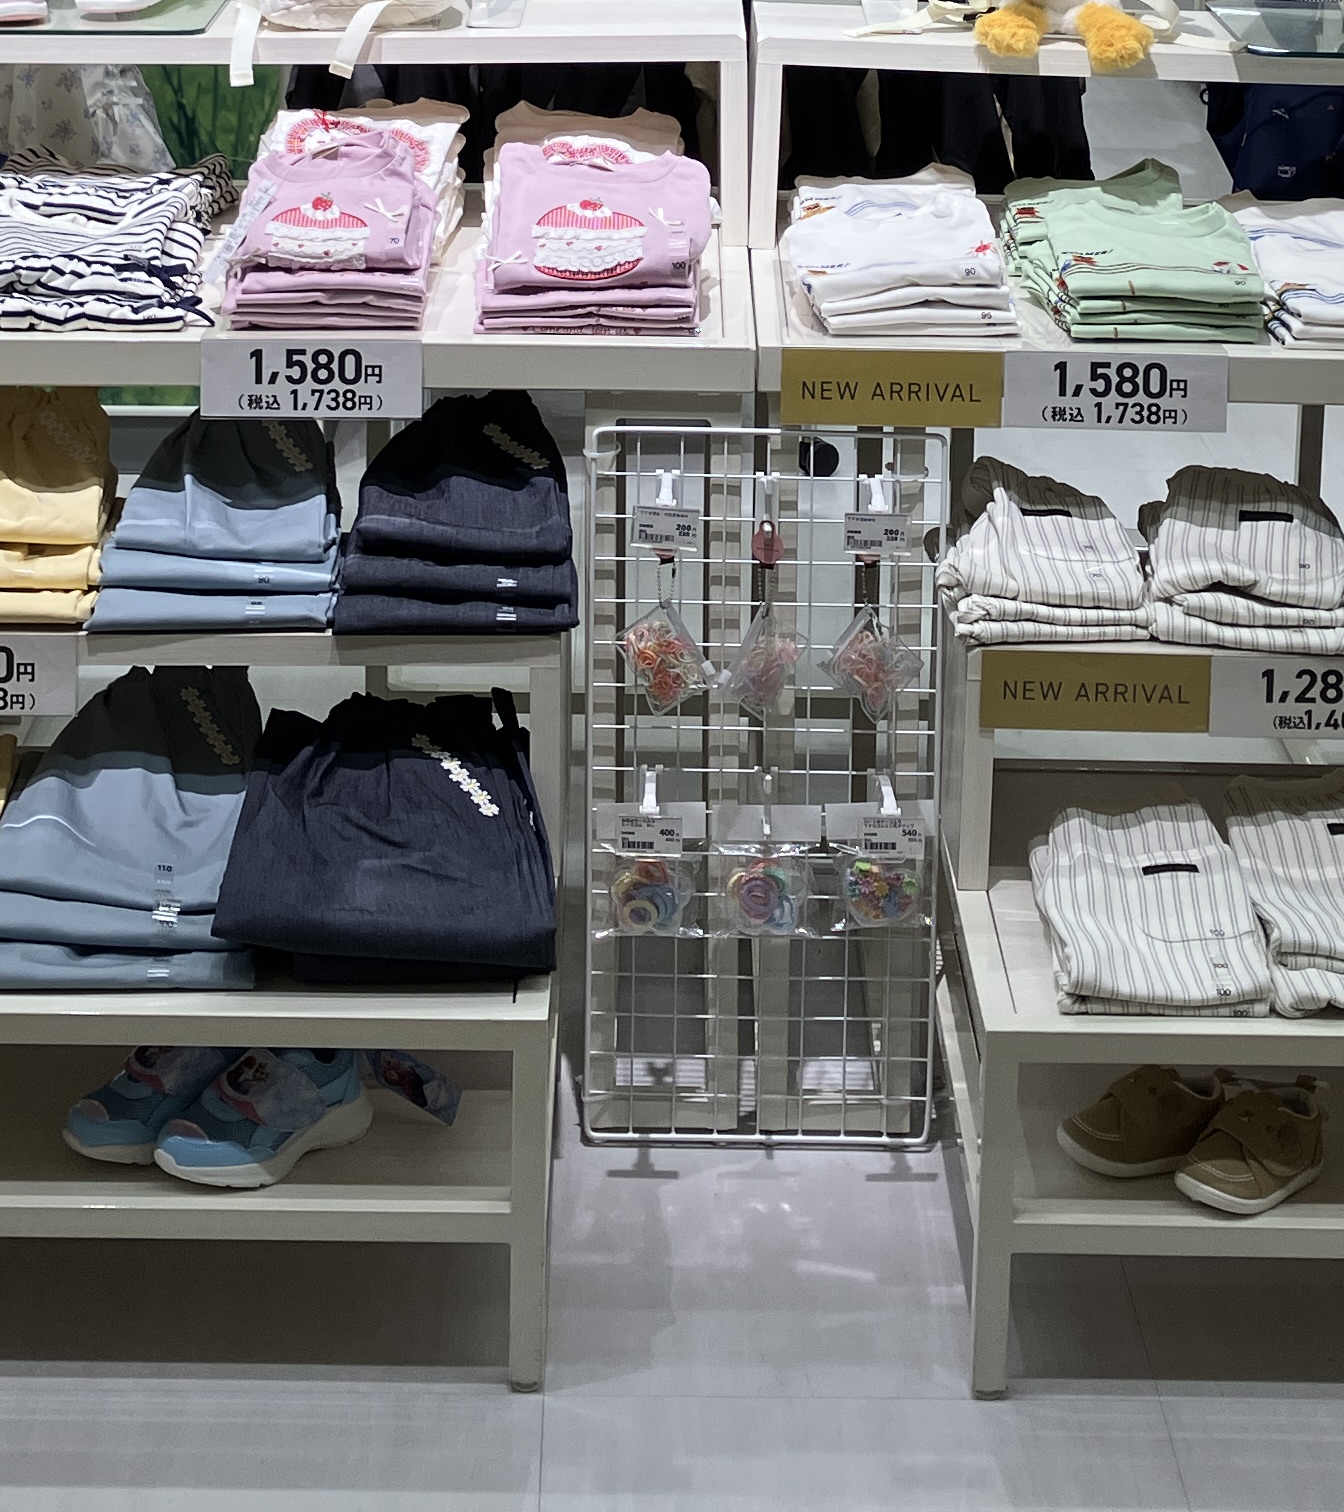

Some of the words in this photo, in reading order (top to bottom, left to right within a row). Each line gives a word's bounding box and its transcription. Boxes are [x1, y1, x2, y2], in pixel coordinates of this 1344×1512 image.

[671, 261, 686, 270] 100
[964, 267, 976, 276] 90
[249, 348, 382, 386] 1,580円
[1053, 361, 1188, 399] 1,580円
[801, 380, 859, 401] NEW
[871, 381, 982, 403] ARRIVAL
[1002, 680, 1063, 701] NEW
[1075, 682, 1190, 705] ARRIVAL
[158, 864, 173, 872] 110
[1209, 929, 1225, 937] 100
[1216, 988, 1232, 996] 100
